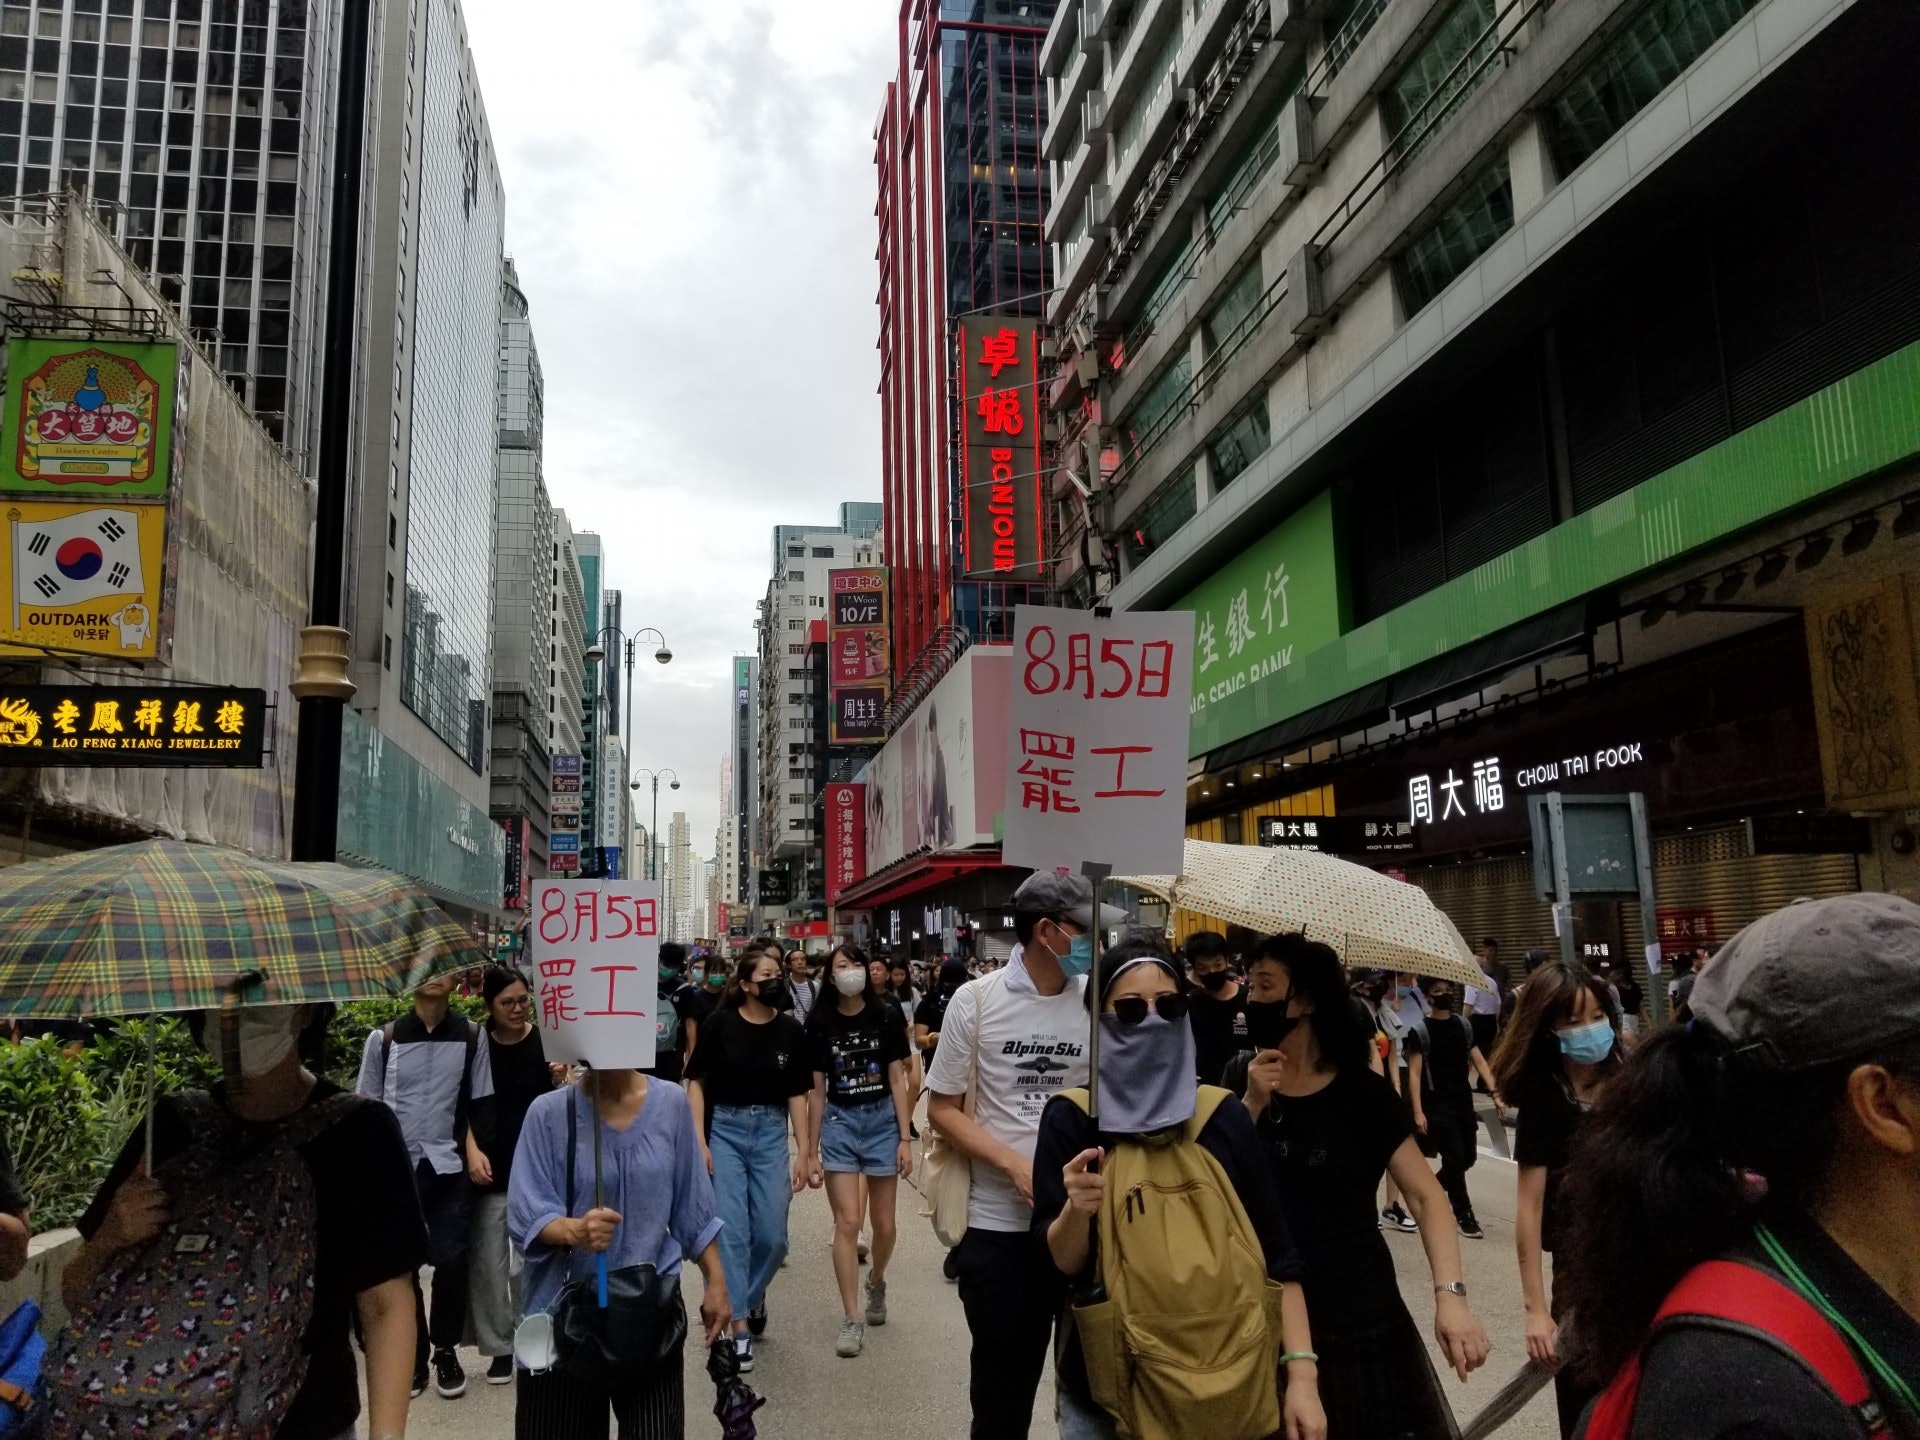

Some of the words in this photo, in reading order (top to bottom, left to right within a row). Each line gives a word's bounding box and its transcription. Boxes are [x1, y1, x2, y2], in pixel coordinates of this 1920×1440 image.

[989, 448, 1016, 573] BONJOUR
[28, 613, 110, 626] OUTDARK
[840, 606, 878, 623] 10/F
[73, 629, 110, 641] 아웃닭
[1023, 625, 1174, 700] 8月5日
[53, 699, 245, 736] 老鳳祥銀樓
[843, 698, 876, 719] 周生生
[52, 738, 78, 748] LAO
[83, 738, 116, 748] FENG
[121, 738, 163, 748] XIANG
[168, 738, 242, 748] JEWELLERY
[1517, 763, 1559, 787] CHOW
[1563, 755, 1589, 776] TAI
[1596, 742, 1643, 770] FOOK
[1409, 757, 1504, 827] 周大福
[1271, 822, 1318, 837] 周大福
[539, 887, 657, 944] 8月5日
[538, 958, 646, 1030] 罷工
